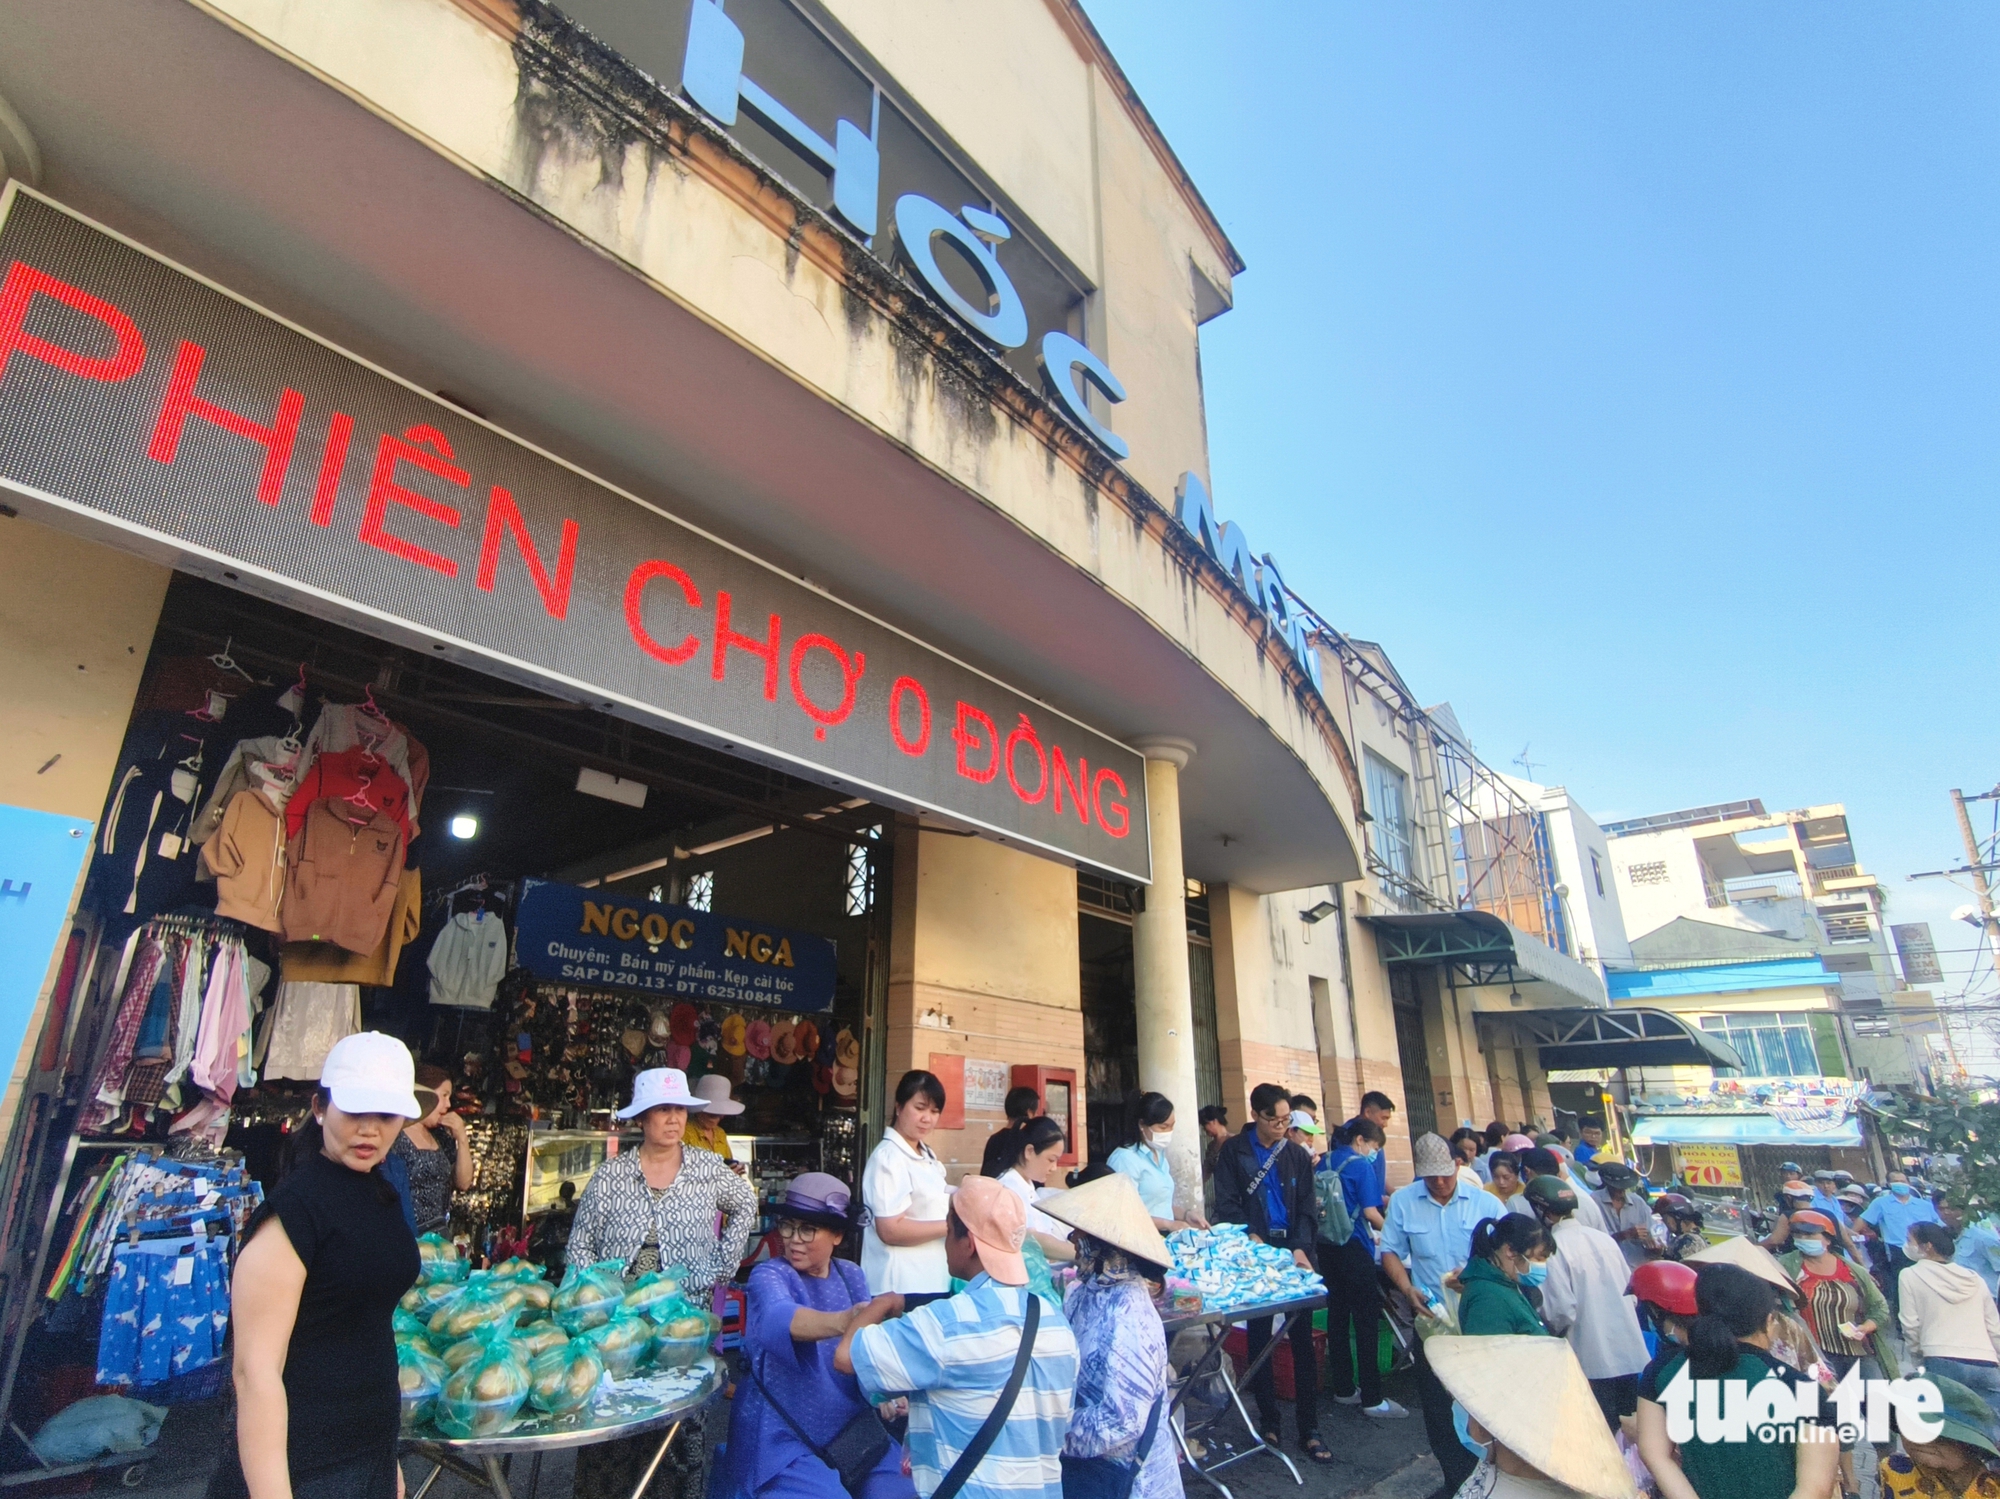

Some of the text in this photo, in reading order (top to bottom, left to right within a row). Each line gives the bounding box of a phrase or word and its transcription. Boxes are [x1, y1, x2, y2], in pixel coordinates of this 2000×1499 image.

[0, 261, 1130, 838] PHIÊN CHỢ 0 ĐỒNG
[580, 901, 795, 968] NGỌC NGA
[547, 941, 610, 964] Chuyên:
[620, 953, 649, 970] Bán
[655, 959, 675, 976] mỹ
[679, 961, 716, 980] phẩm
[724, 969, 749, 987] Kẹp
[754, 974, 772, 988] cài
[776, 977, 794, 991] tóc
[561, 964, 600, 980] SẠP
[602, 970, 666, 989] D20.13
[707, 984, 782, 1004] 62510845
[1685, 1166, 1723, 1185] 70
